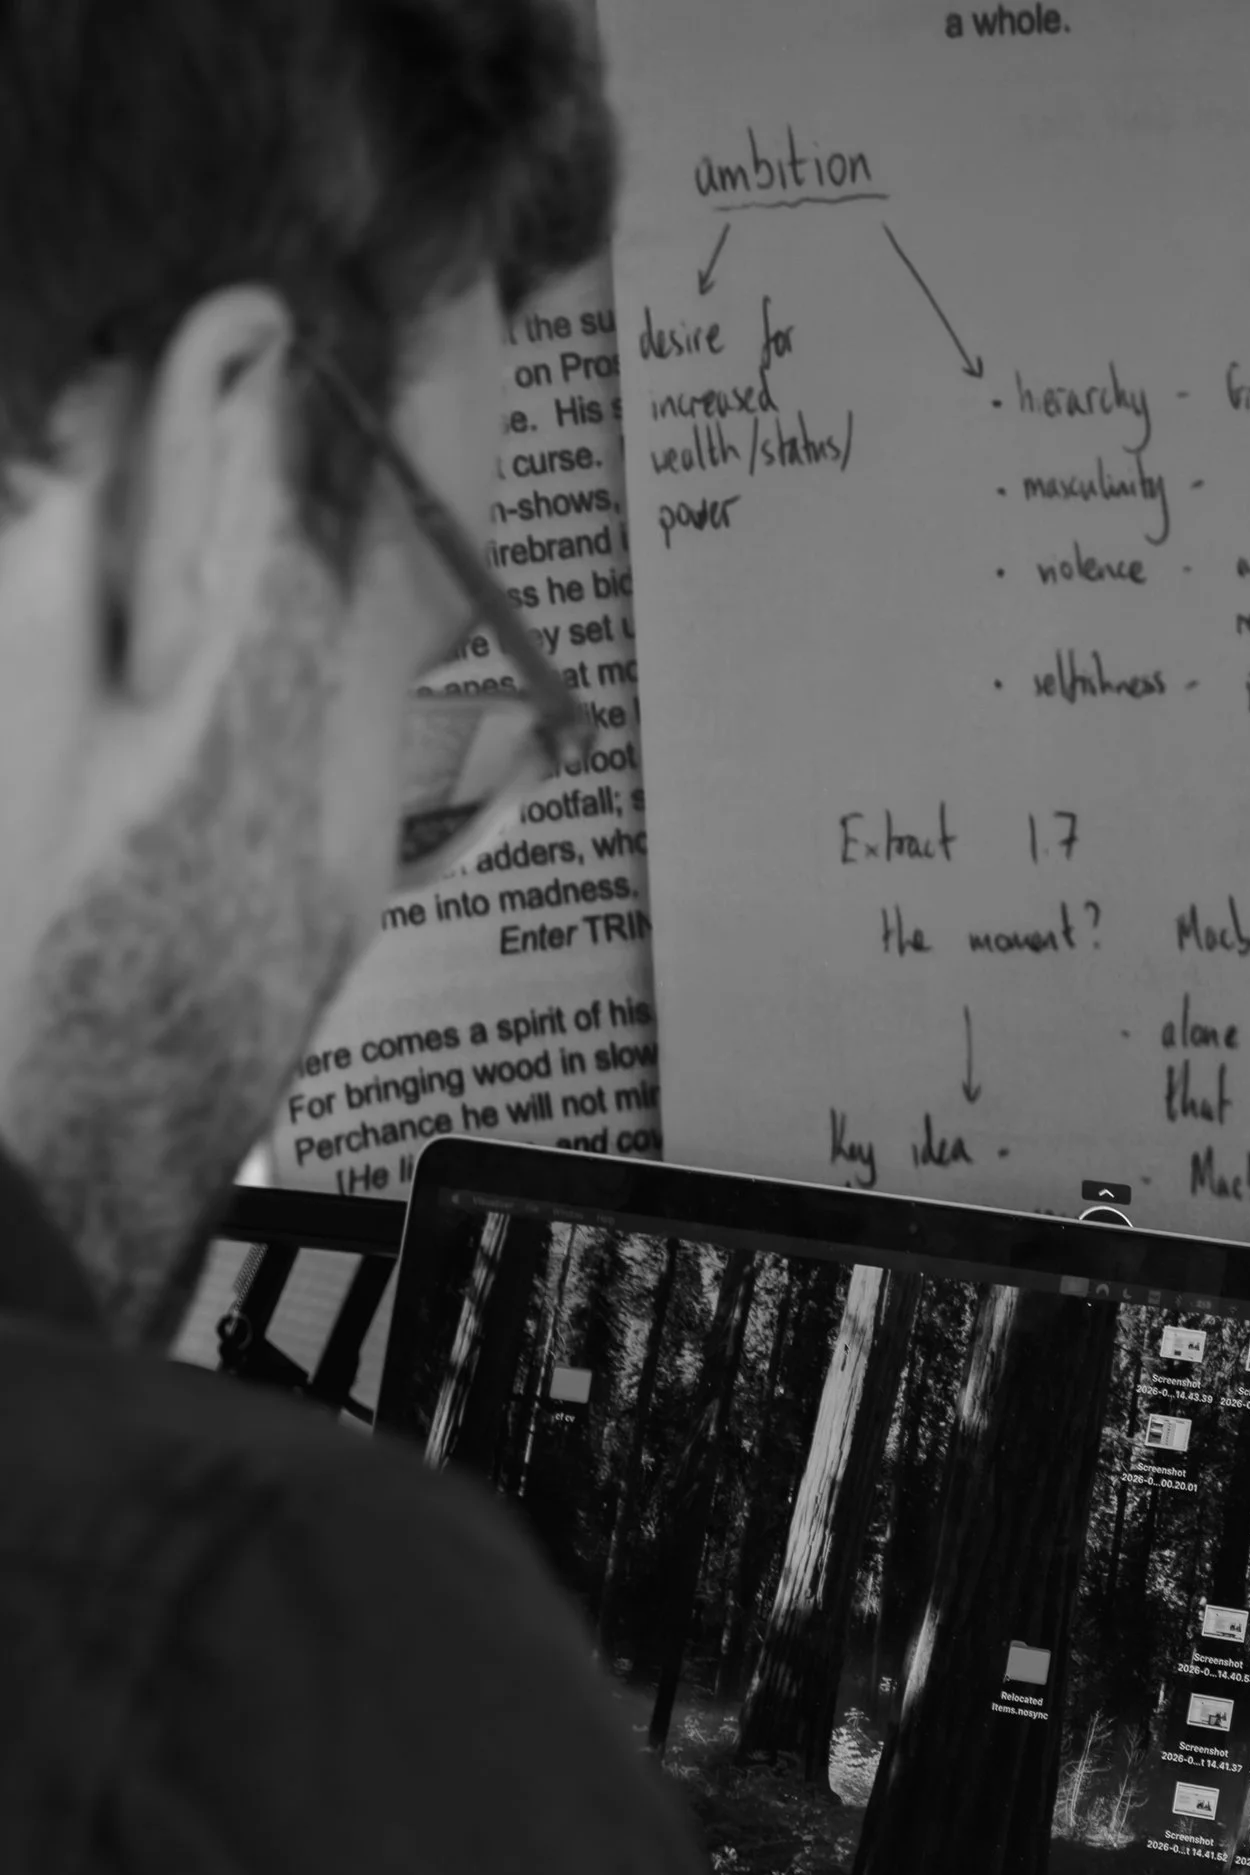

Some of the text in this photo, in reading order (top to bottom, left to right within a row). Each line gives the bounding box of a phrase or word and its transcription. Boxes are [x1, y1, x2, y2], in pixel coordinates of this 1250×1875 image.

[945, 3, 1072, 38] a whole.
[695, 123, 872, 195] ambition
[638, 306, 724, 360] desire
[515, 359, 552, 389] on
[651, 367, 778, 420] increased
[555, 395, 604, 428] His
[513, 445, 603, 477] curse.
[1037, 539, 1147, 585] violence
[839, 803, 957, 863] Extract
[476, 837, 584, 875] adders,
[435, 890, 489, 923] into
[500, 876, 639, 915] madness.
[501, 922, 577, 957] Enter
[970, 901, 1102, 953] moment?
[362, 995, 652, 1064] comes a spirit of his
[288, 1091, 336, 1124] For
[345, 1065, 465, 1110] bringing
[474, 1048, 551, 1085] wood
[560, 1045, 586, 1076] in
[1167, 1060, 1233, 1127] that
[295, 1086, 607, 1166] Perchance he will not
[831, 1108, 972, 1185] Key idea
[1151, 1372, 1201, 1389] Screenshot
[1137, 1462, 1186, 1478] Screenshot
[1193, 1652, 1243, 1670] Screenshot
[1000, 1690, 1044, 1706] Relocated
[1179, 1740, 1229, 1758] Screenshot
[1164, 1829, 1214, 1847] Screenshot
